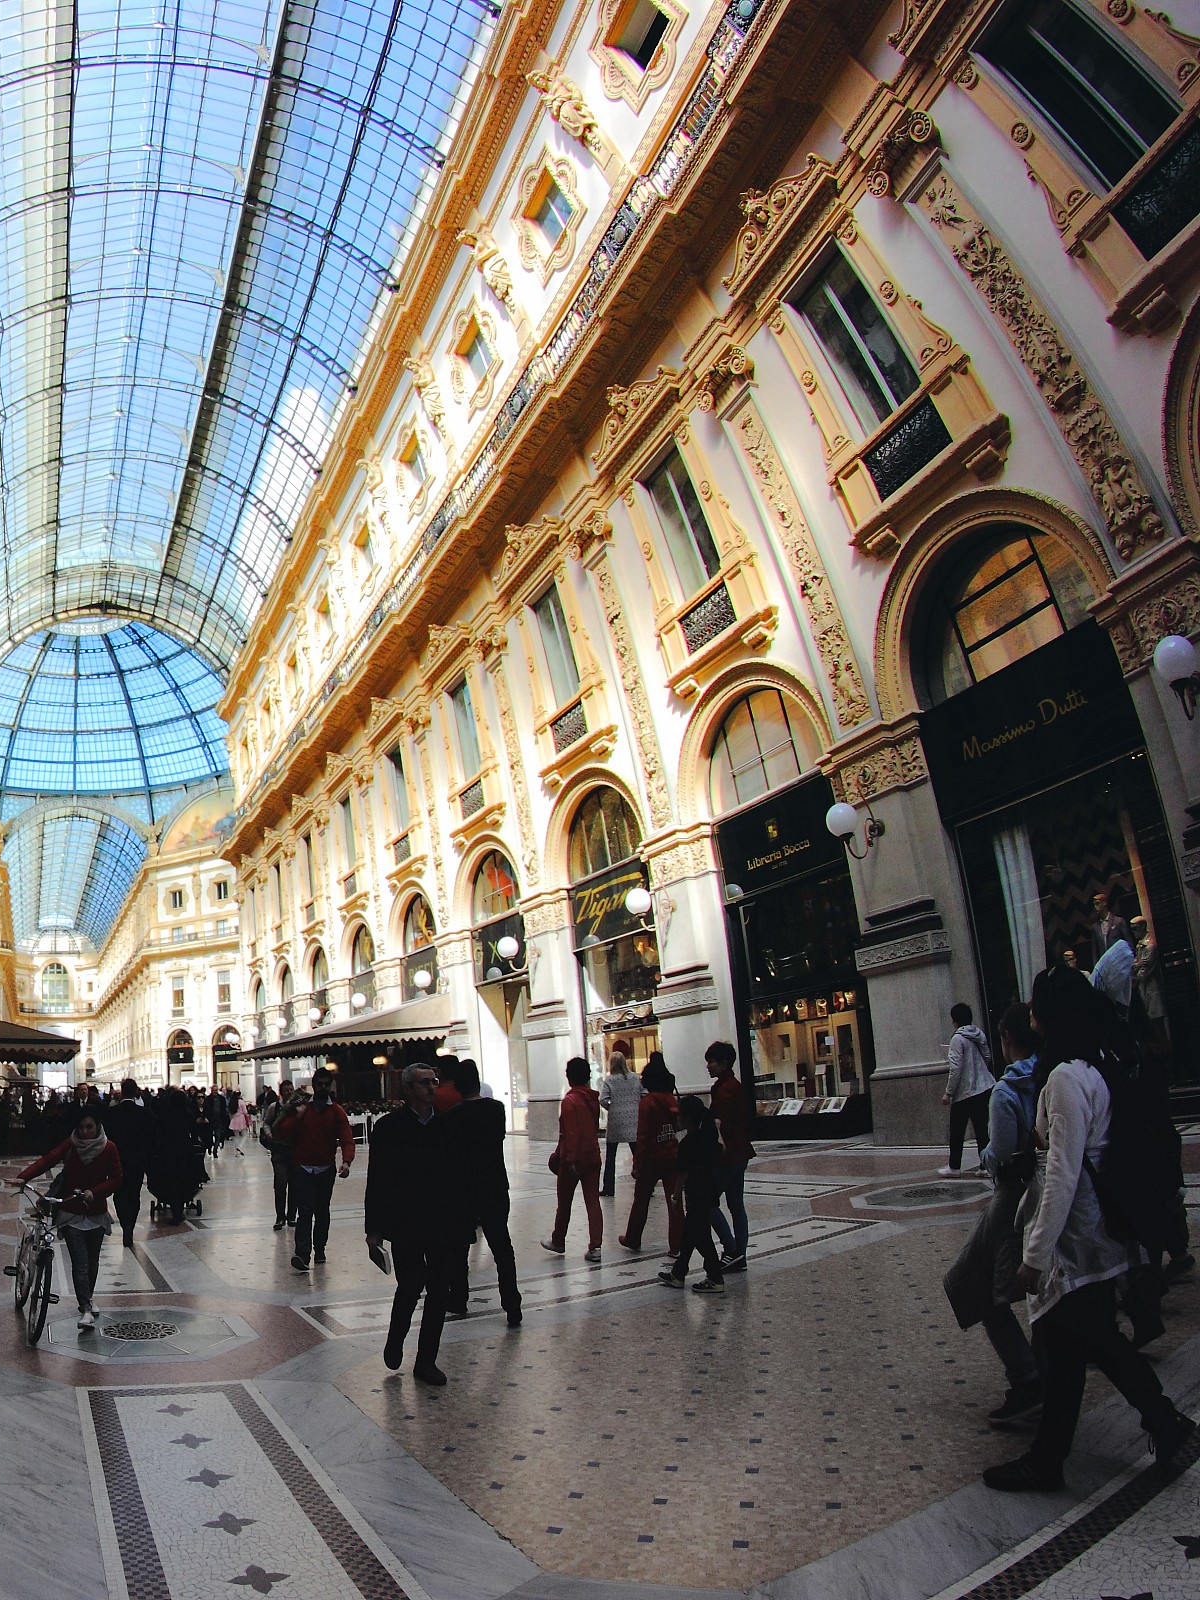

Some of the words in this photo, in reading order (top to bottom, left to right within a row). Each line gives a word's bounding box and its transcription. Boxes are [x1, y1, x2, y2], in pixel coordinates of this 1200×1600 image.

[962, 720, 1036, 761] Massimo
[1037, 689, 1089, 725] Dutti
[747, 850, 782, 871] Libreria
[782, 839, 811, 857] Bocca
